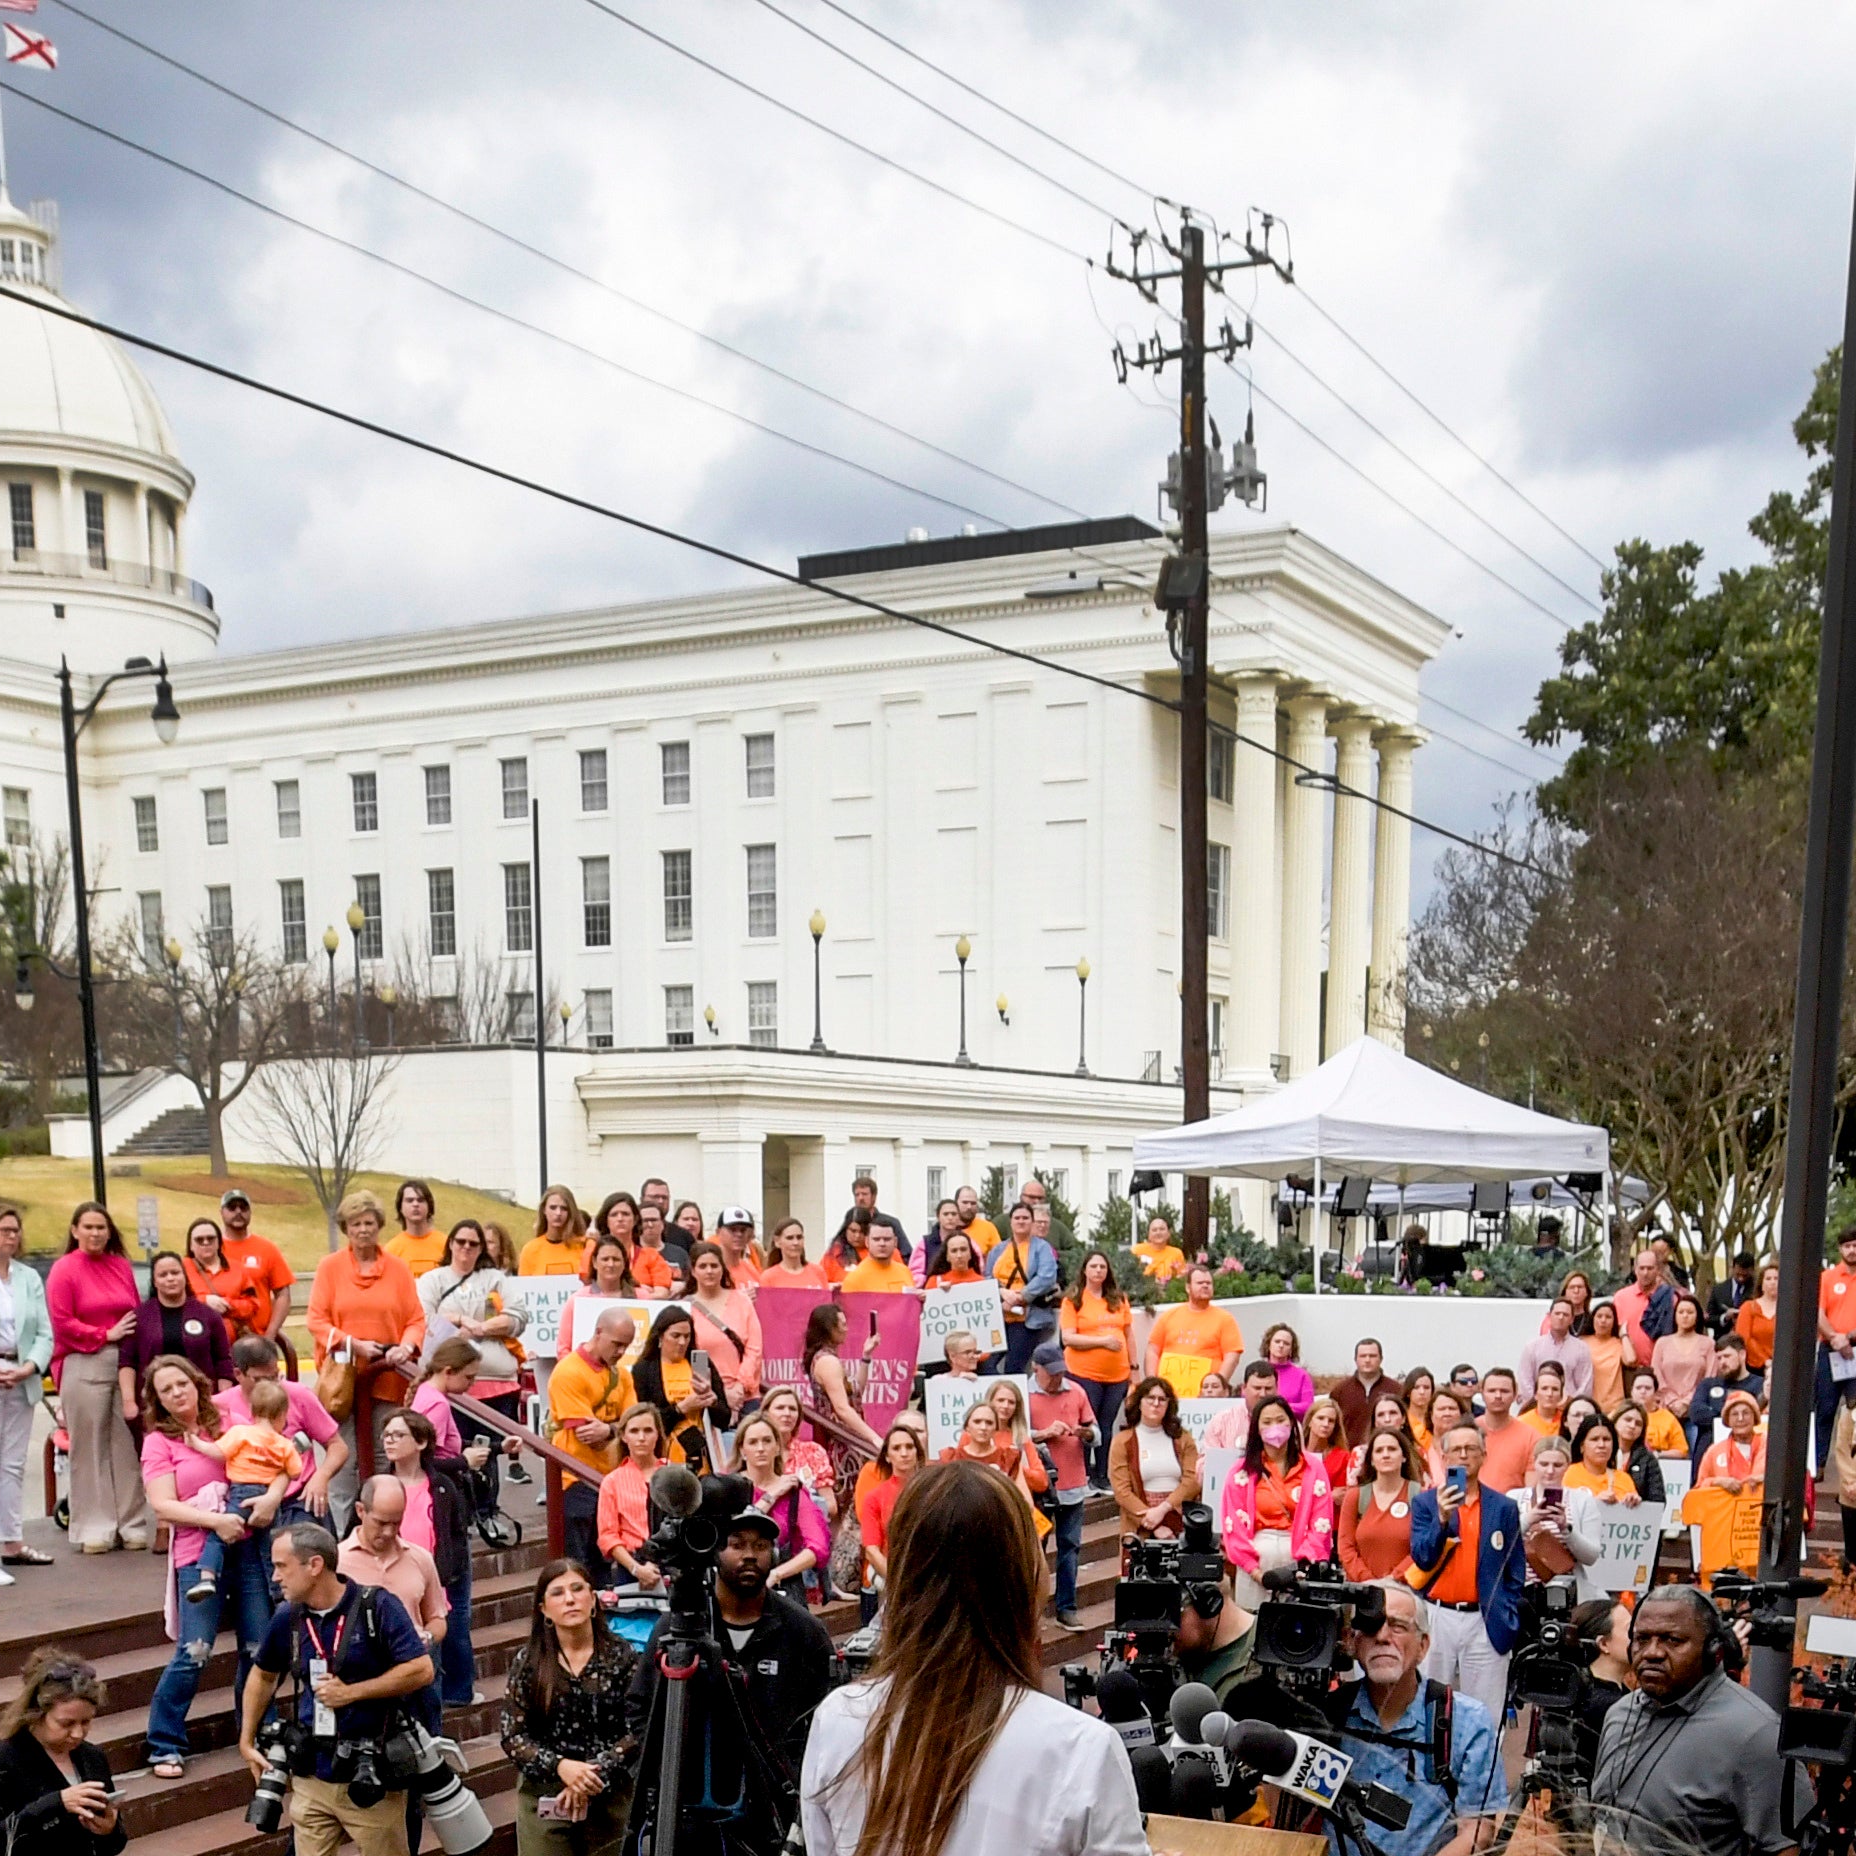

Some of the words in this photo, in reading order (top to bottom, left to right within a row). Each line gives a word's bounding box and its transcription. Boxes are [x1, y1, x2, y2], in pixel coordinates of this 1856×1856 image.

[967, 1313, 991, 1330] IVF
[1163, 1357, 1200, 1376] IVF
[1180, 1412, 1216, 1425] FIGH
[1602, 1523, 1653, 1541] TORS
[1616, 1543, 1644, 1561] IVF
[1292, 1746, 1321, 1788] WAKA
[1313, 1751, 1345, 1790] 8
